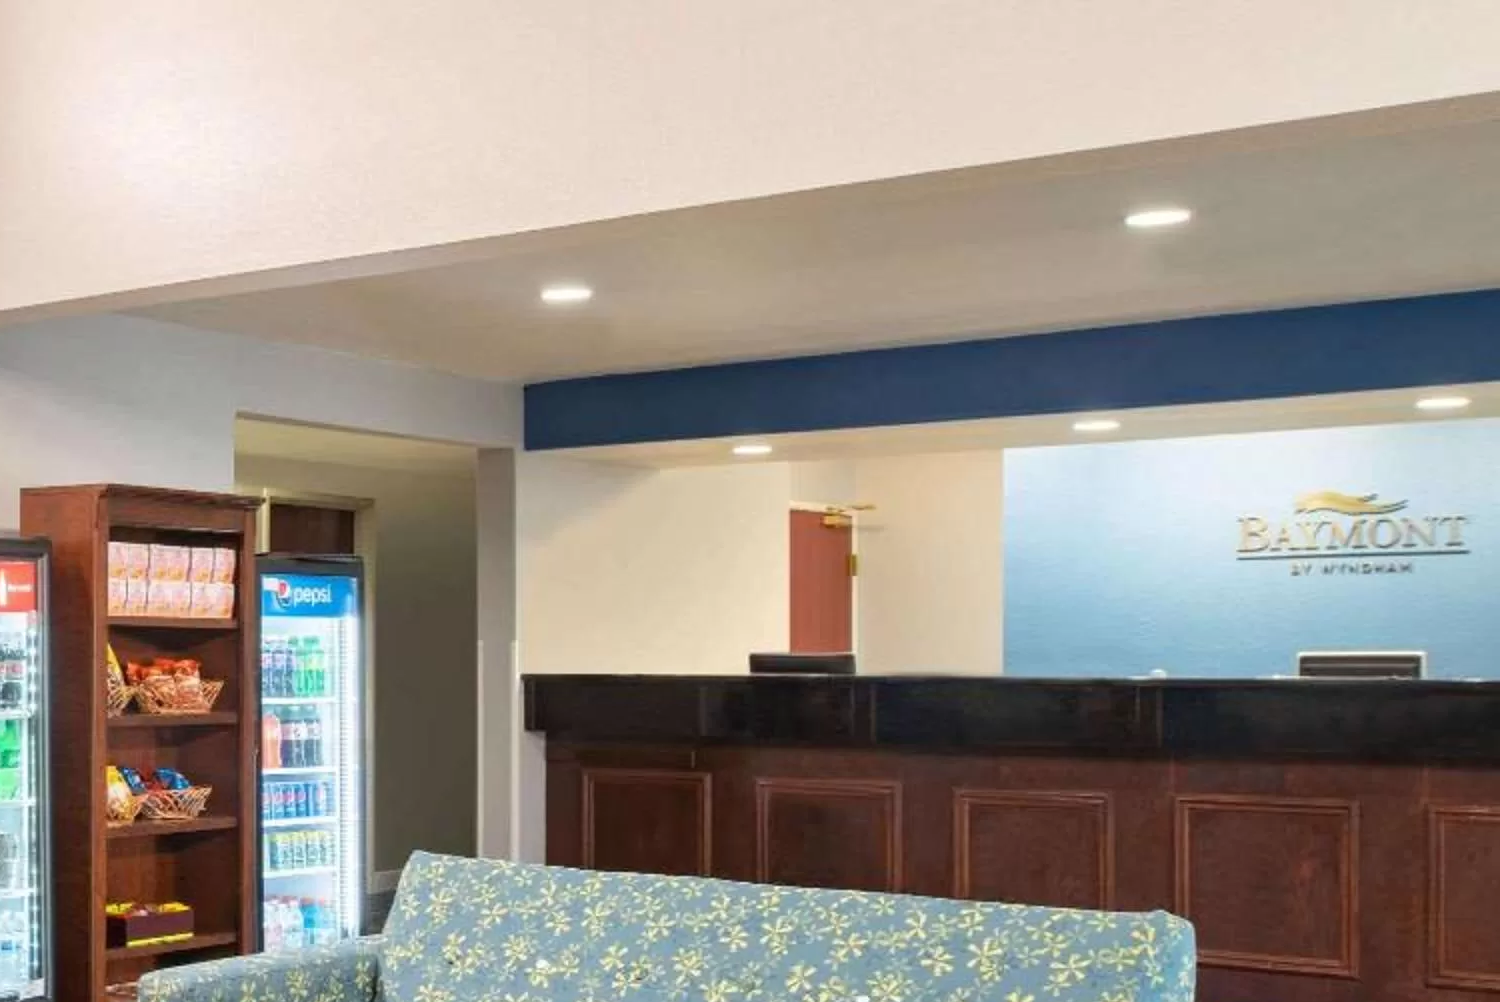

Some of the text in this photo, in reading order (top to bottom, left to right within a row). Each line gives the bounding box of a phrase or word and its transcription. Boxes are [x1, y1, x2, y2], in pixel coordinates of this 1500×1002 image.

[1236, 515, 1469, 552] BAYMONT
[1290, 562, 1413, 576] BY WYNDHAM
[293, 583, 332, 608] pepsi
